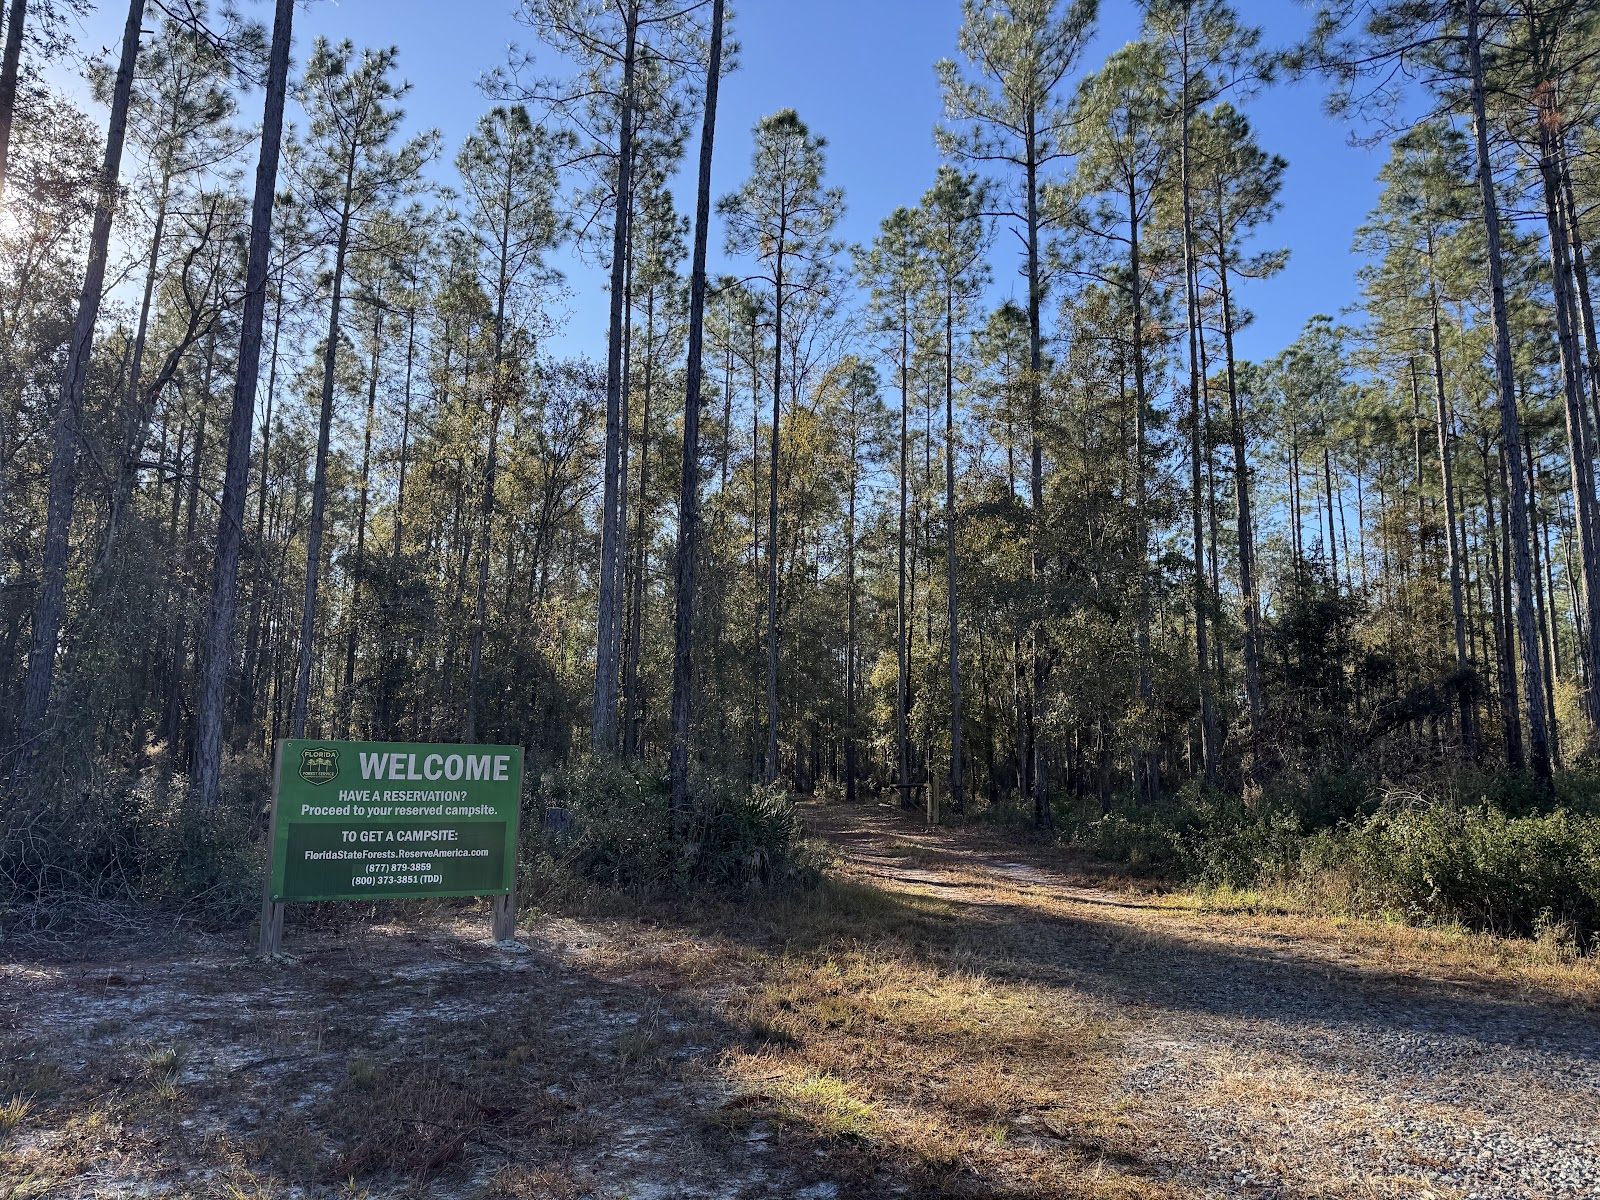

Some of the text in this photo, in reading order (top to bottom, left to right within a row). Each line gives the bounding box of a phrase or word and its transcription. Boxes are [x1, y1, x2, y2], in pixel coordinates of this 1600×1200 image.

[359, 752, 510, 780] WELCOME
[338, 790, 467, 802] HAVE A RESERVATION?
[301, 804, 498, 818] Proceed to your reserved campsite.
[341, 830, 459, 842] TO GET A CAMPSITE:
[304, 848, 489, 860] FloridaStateForests.ReserveAmerica.com
[365, 862, 432, 874] (877) 879-3859
[351, 874, 443, 887] (800) 373-3851 (TDD)
